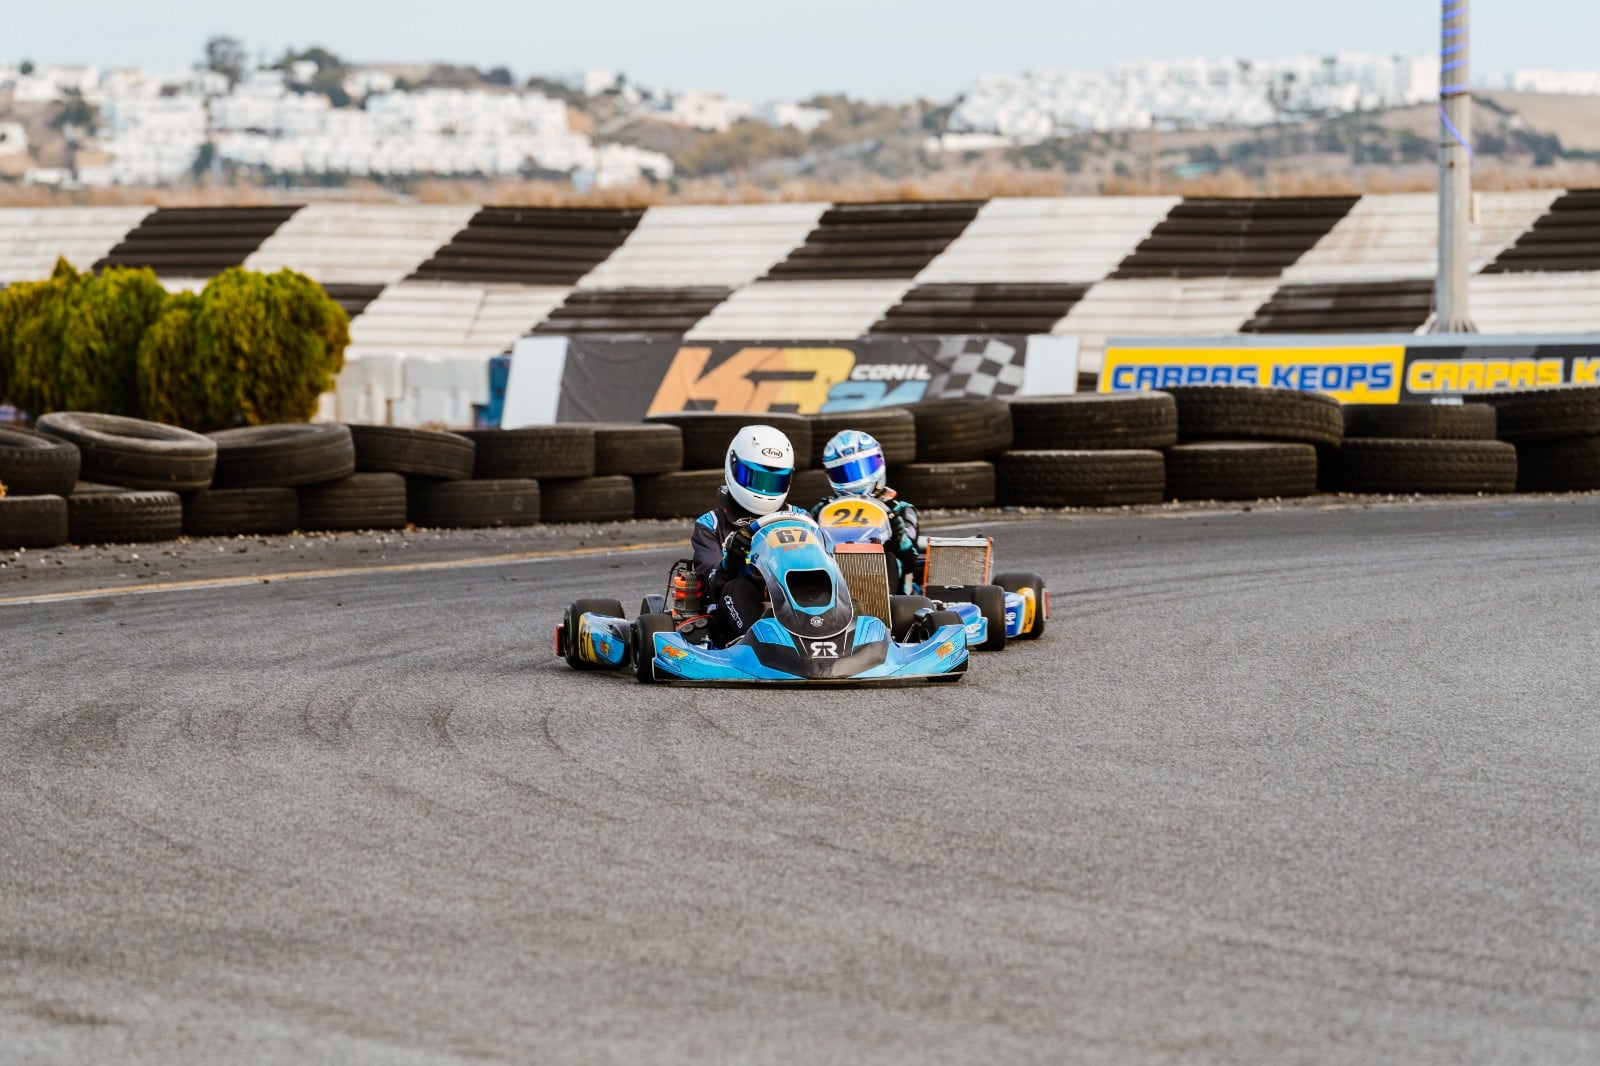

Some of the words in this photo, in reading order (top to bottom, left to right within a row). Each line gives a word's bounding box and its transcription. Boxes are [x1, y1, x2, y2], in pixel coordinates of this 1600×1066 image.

[851, 364, 931, 380] CONIL
[1111, 364, 1258, 391] CARPAS
[1271, 362, 1394, 392] KEOPS
[1406, 358, 1564, 394] CARPAS
[832, 508, 869, 525] 24
[775, 529, 809, 544] 67
